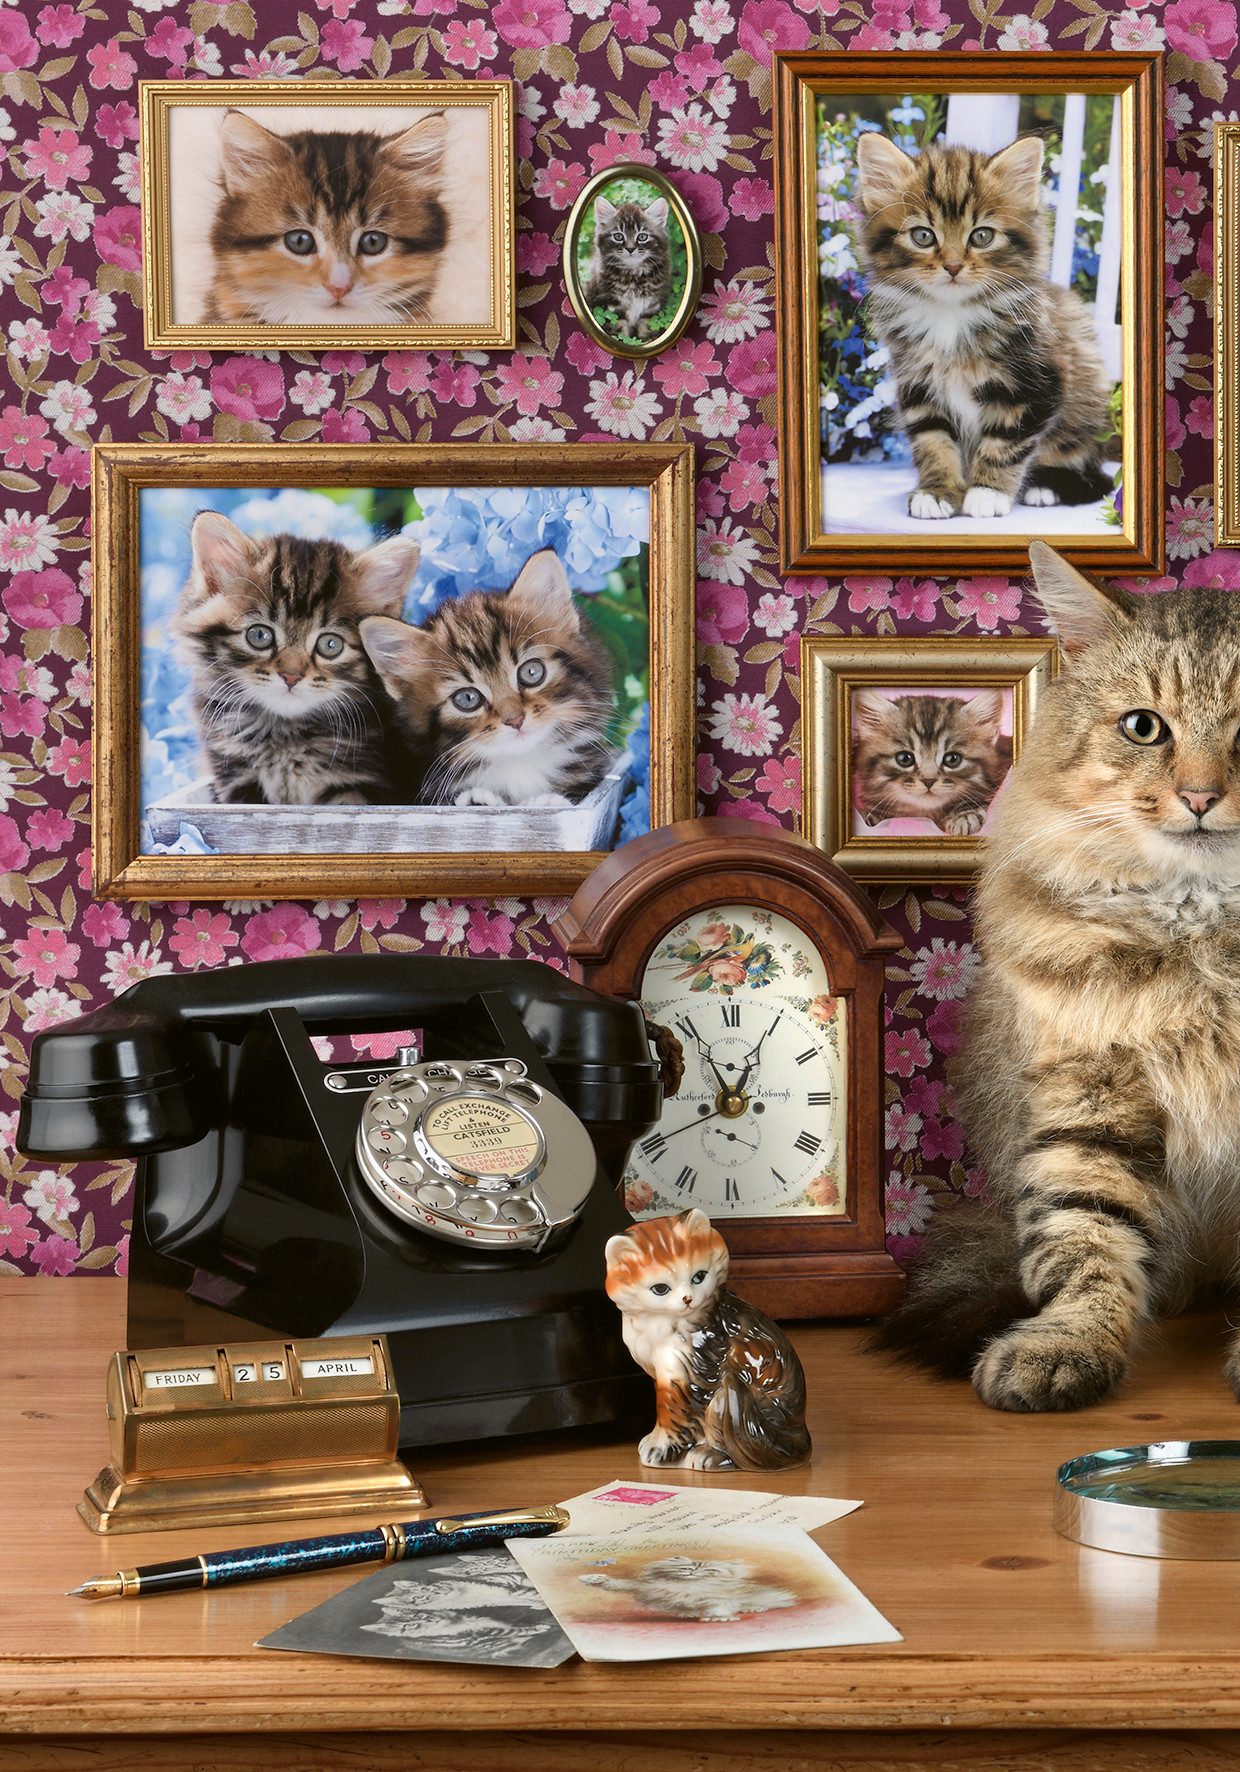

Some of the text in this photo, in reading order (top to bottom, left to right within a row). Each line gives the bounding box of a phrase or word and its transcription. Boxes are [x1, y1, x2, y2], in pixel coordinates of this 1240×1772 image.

[720, 1004, 740, 1028] XII
[793, 1047, 819, 1066] II
[808, 1091, 831, 1106] III
[432, 1103, 511, 1128] TO CALL EXCHANGE
[442, 1109, 508, 1130] LIFT TELEPHONE
[453, 1126, 511, 1140] CATSFIELD
[459, 1121, 490, 1130] LISTEN
[470, 1137, 502, 1148] 3339
[455, 1152, 488, 1163] SPEECH
[463, 1156, 514, 1168] TELEPHONE
[156, 1363, 358, 1385] FRIDAY 2 5 APRIL
